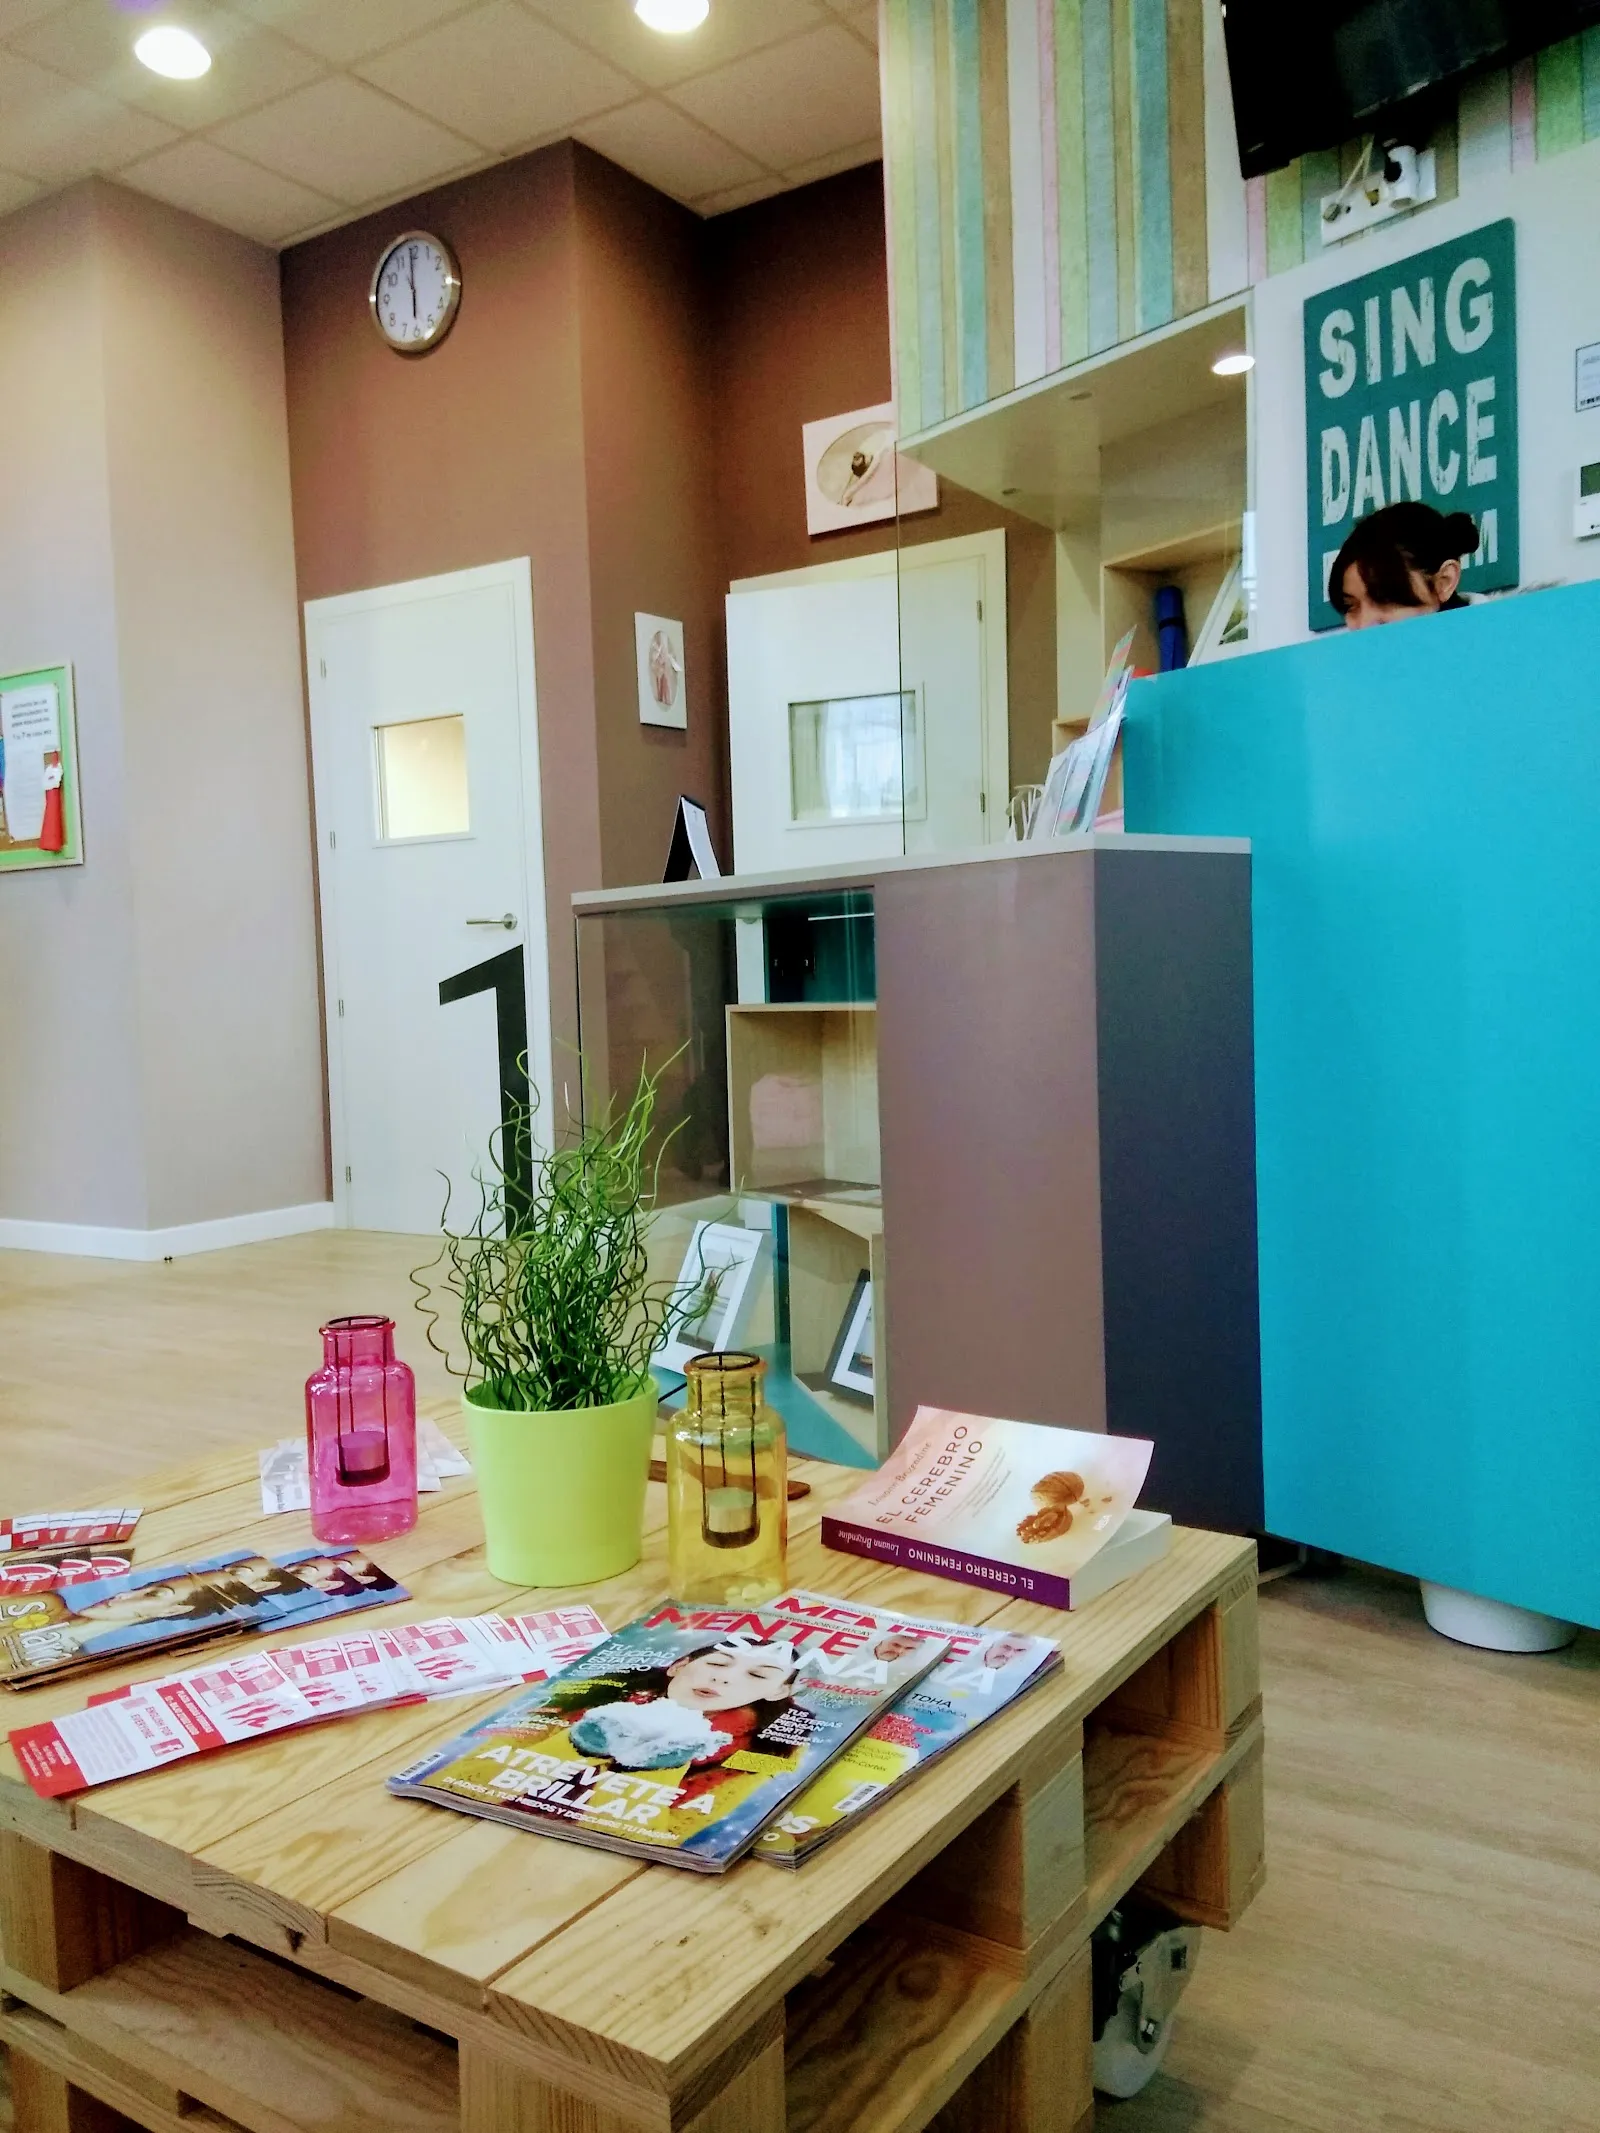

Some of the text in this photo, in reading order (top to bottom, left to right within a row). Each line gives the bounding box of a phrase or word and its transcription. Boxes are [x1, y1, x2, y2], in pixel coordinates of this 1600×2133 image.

[1319, 257, 1494, 400] SING
[1321, 375, 1498, 527] DANCE
[438, 943, 536, 1242] 1
[876, 1426, 968, 1524] EL CEREBRO
[904, 1441, 983, 1523] FEMENINO
[908, 1548, 962, 1571] FEMENINO
[965, 1563, 1017, 1585] CEREBRO
[1021, 1577, 1034, 1590] EL
[643, 1607, 869, 1656] MENTE
[713, 1632, 889, 1685] SANA
[911, 1692, 951, 1708] TDHA
[779, 1713, 844, 1729] BACTERIAS
[787, 1708, 809, 1718] TUS
[761, 1728, 811, 1742] Descubre
[767, 1723, 793, 1734] POR
[773, 1718, 824, 1732] PIENSAN
[488, 1768, 662, 1825] BRILLAR
[677, 1793, 715, 1815] A
[485, 1788, 498, 1797] A
[497, 1791, 518, 1802] TUS
[514, 1795, 557, 1813] MIEDOS
[554, 1806, 566, 1815] Y
[564, 1808, 622, 1829] DESCUBRE
[622, 1823, 638, 1832] TU
